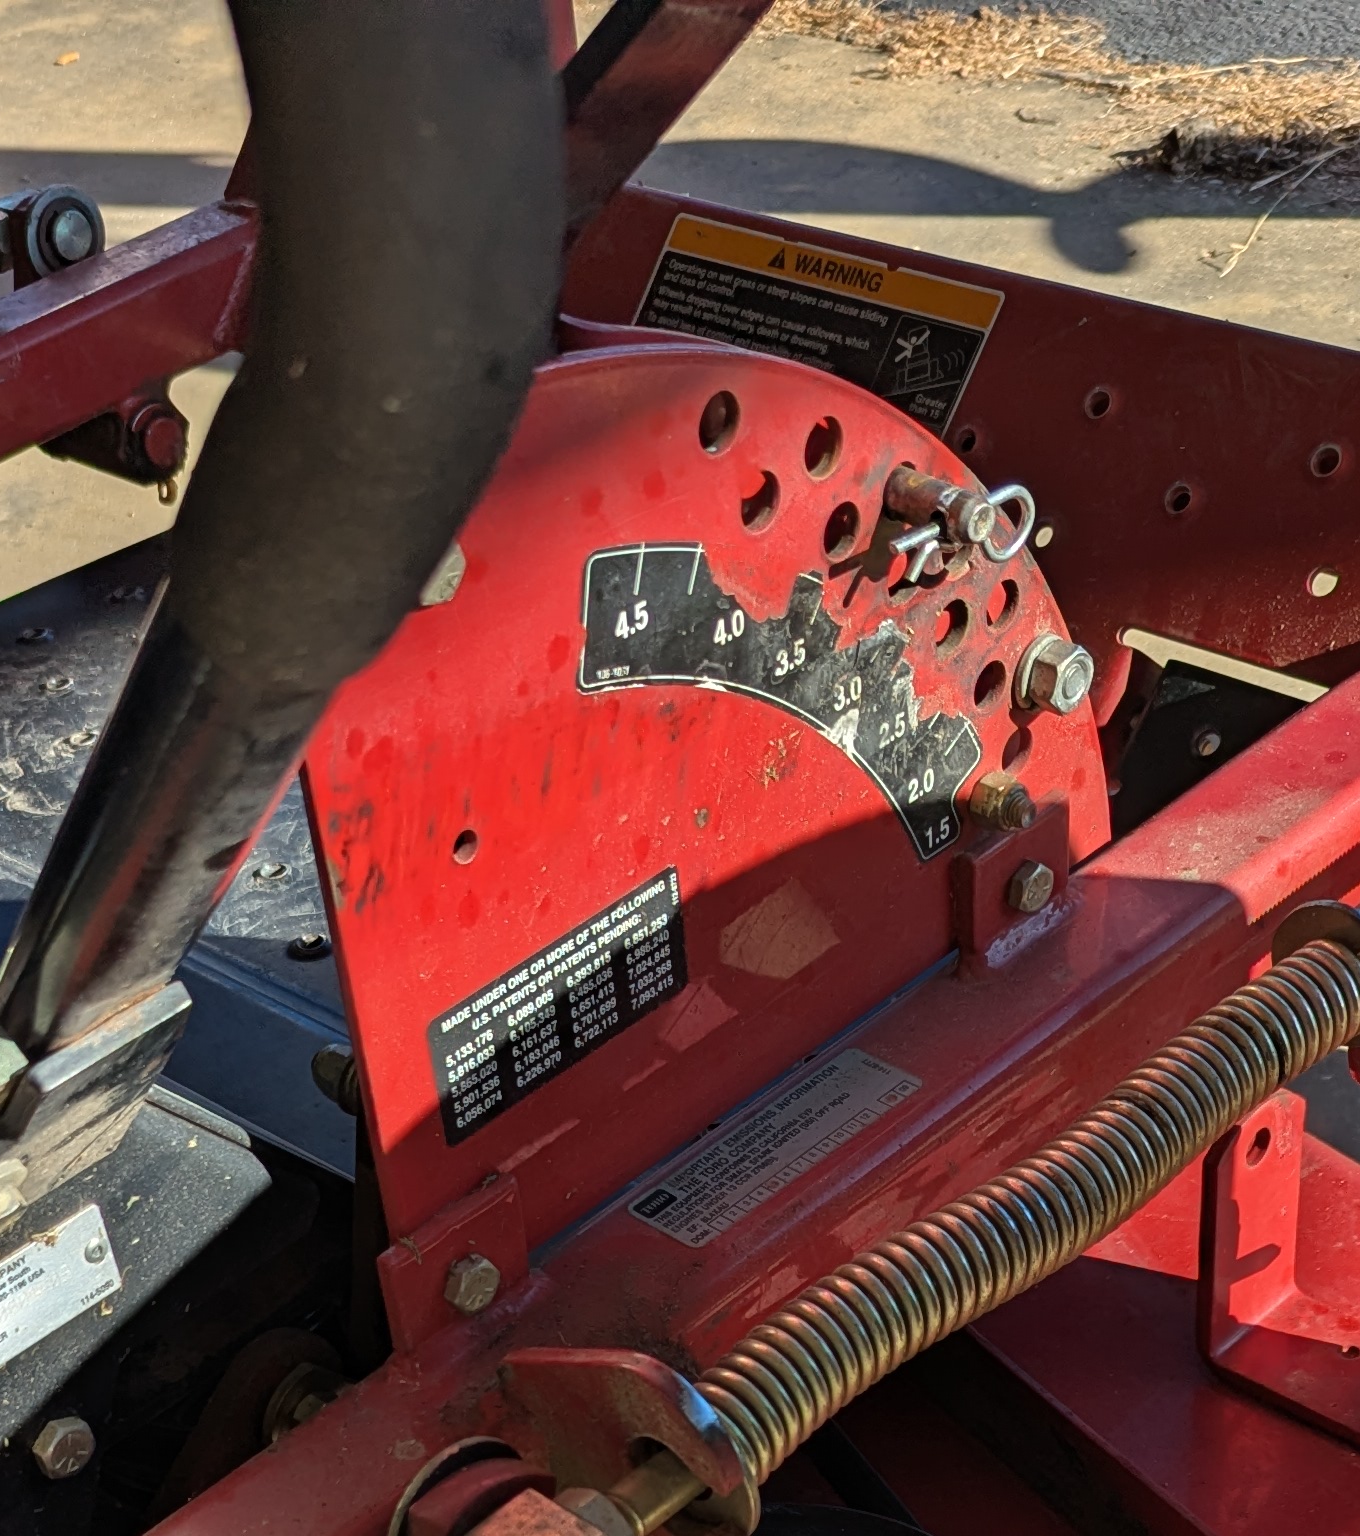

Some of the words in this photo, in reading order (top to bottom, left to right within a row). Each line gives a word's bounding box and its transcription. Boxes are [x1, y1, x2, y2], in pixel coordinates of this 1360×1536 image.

[662, 270, 680, 282] and
[678, 274, 697, 287] loss
[666, 258, 708, 279] Operating
[705, 270, 718, 280] on
[788, 290, 818, 308] slopes
[816, 298, 834, 310] can
[832, 302, 859, 317] cause
[857, 307, 890, 327] sliding
[790, 252, 886, 293] WARNING
[738, 307, 766, 323] edges
[843, 334, 871, 350] which
[913, 393, 947, 409] Greater
[614, 601, 649, 640] 4.5
[713, 610, 745, 646] 4.0
[774, 638, 807, 678] 3.5
[833, 675, 862, 712] 3.0
[878, 712, 906, 749] 2.5
[908, 768, 935, 804] 2.0
[924, 816, 951, 849] 1.5
[440, 1004, 471, 1035] MADE
[471, 981, 507, 1014] UNDER
[507, 966, 529, 992] ONE
[530, 956, 545, 977] OR
[545, 939, 572, 967] MORE
[572, 929, 588, 949] OF
[587, 914, 609, 940] THE
[610, 878, 665, 924] FOLLOWING
[471, 1009, 492, 1032] U.S.
[491, 979, 537, 1019] PATENTS
[537, 968, 552, 989] OR
[553, 939, 597, 979] PATENTS
[597, 910, 642, 949] PENDING:
[444, 1026, 494, 1070] 5,133,176
[511, 1018, 558, 1060] 6,161,637
[574, 1009, 618, 1051] 6,722,113
[721, 1109, 779, 1147] EMISSIONS
[772, 1064, 842, 1110] INFORMATION
[832, 1131, 845, 1139] 10
[859, 1112, 871, 1120] 12
[676, 1176, 703, 1194] THE
[697, 1156, 731, 1178] TORO
[726, 1123, 778, 1157] COMPANY
[708, 1180, 728, 1194] FOR
[724, 1163, 752, 1182] SMALL
[813, 1106, 831, 1118] OFF
[827, 1091, 853, 1108] ROAD
[708, 1153, 752, 1183] CONFORMS
[747, 1146, 761, 1155] TO
[755, 1117, 802, 1148] CALIFORNIA
[700, 1190, 729, 1210] UNDER
[734, 1172, 753, 1186] CCR
[7, 1264, 31, 1284] South
[27, 1266, 45, 1283] USA
